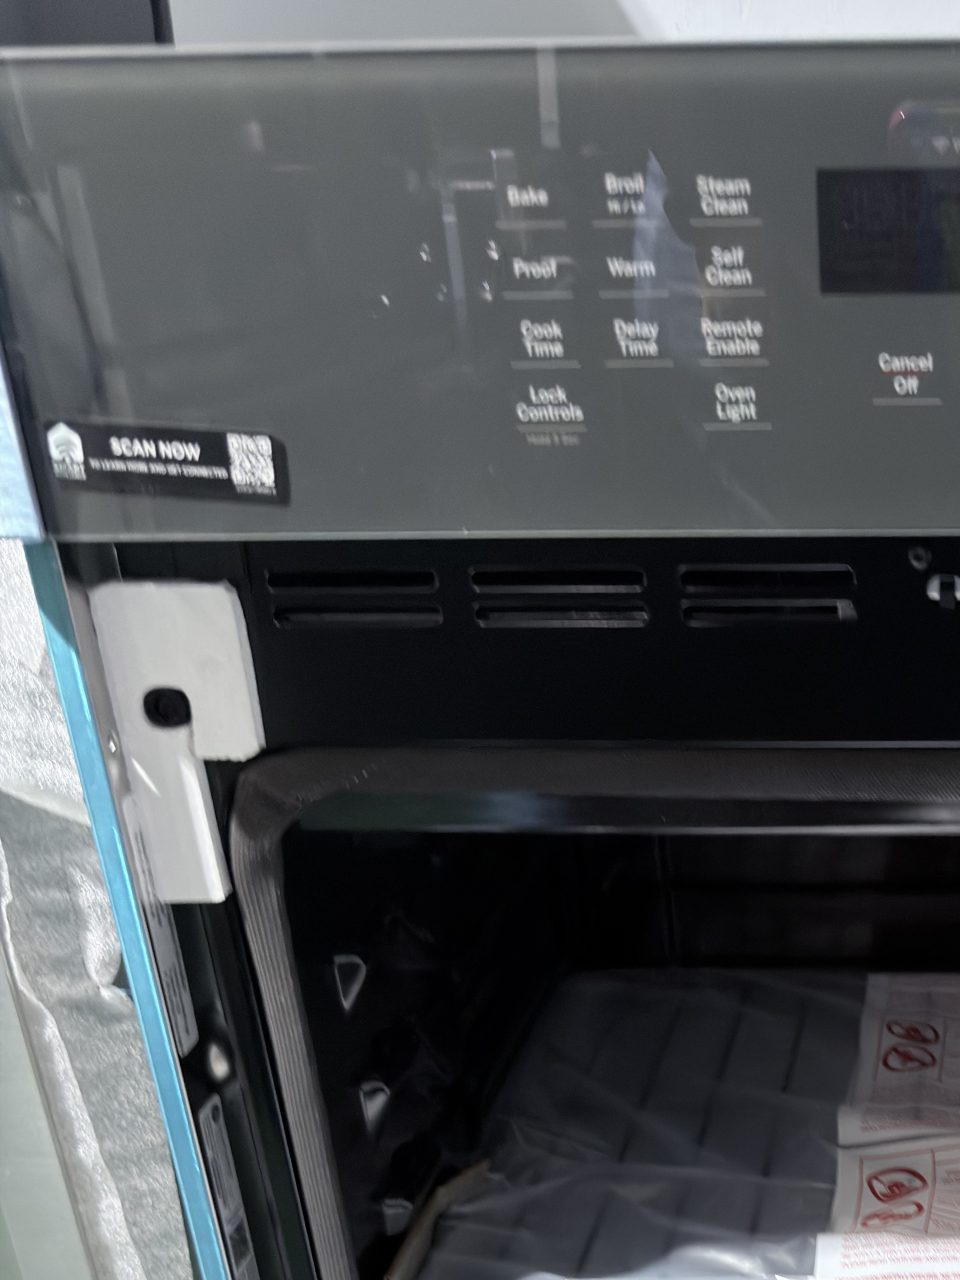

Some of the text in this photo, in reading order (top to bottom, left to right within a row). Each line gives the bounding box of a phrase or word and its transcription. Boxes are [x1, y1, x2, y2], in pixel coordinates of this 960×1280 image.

[605, 172, 645, 195] Broil
[697, 175, 751, 196] Steam
[507, 185, 549, 207] Bake
[701, 195, 749, 216] Clean
[513, 257, 558, 279] Proof
[606, 257, 656, 277] Warm
[705, 265, 752, 286] Clean
[520, 319, 563, 340] Cook
[613, 319, 659, 344] Delay
[701, 318, 763, 338] Remote
[524, 337, 564, 358] Time
[619, 338, 659, 357] Time
[706, 336, 761, 356] Enable
[879, 352, 933, 372] Cancel
[529, 385, 567, 404] Lock
[715, 382, 756, 403] Oven
[894, 375, 919, 396] Off
[516, 401, 584, 422] Controls
[716, 400, 757, 424] Light
[109, 436, 201, 462] SCAN NOW
